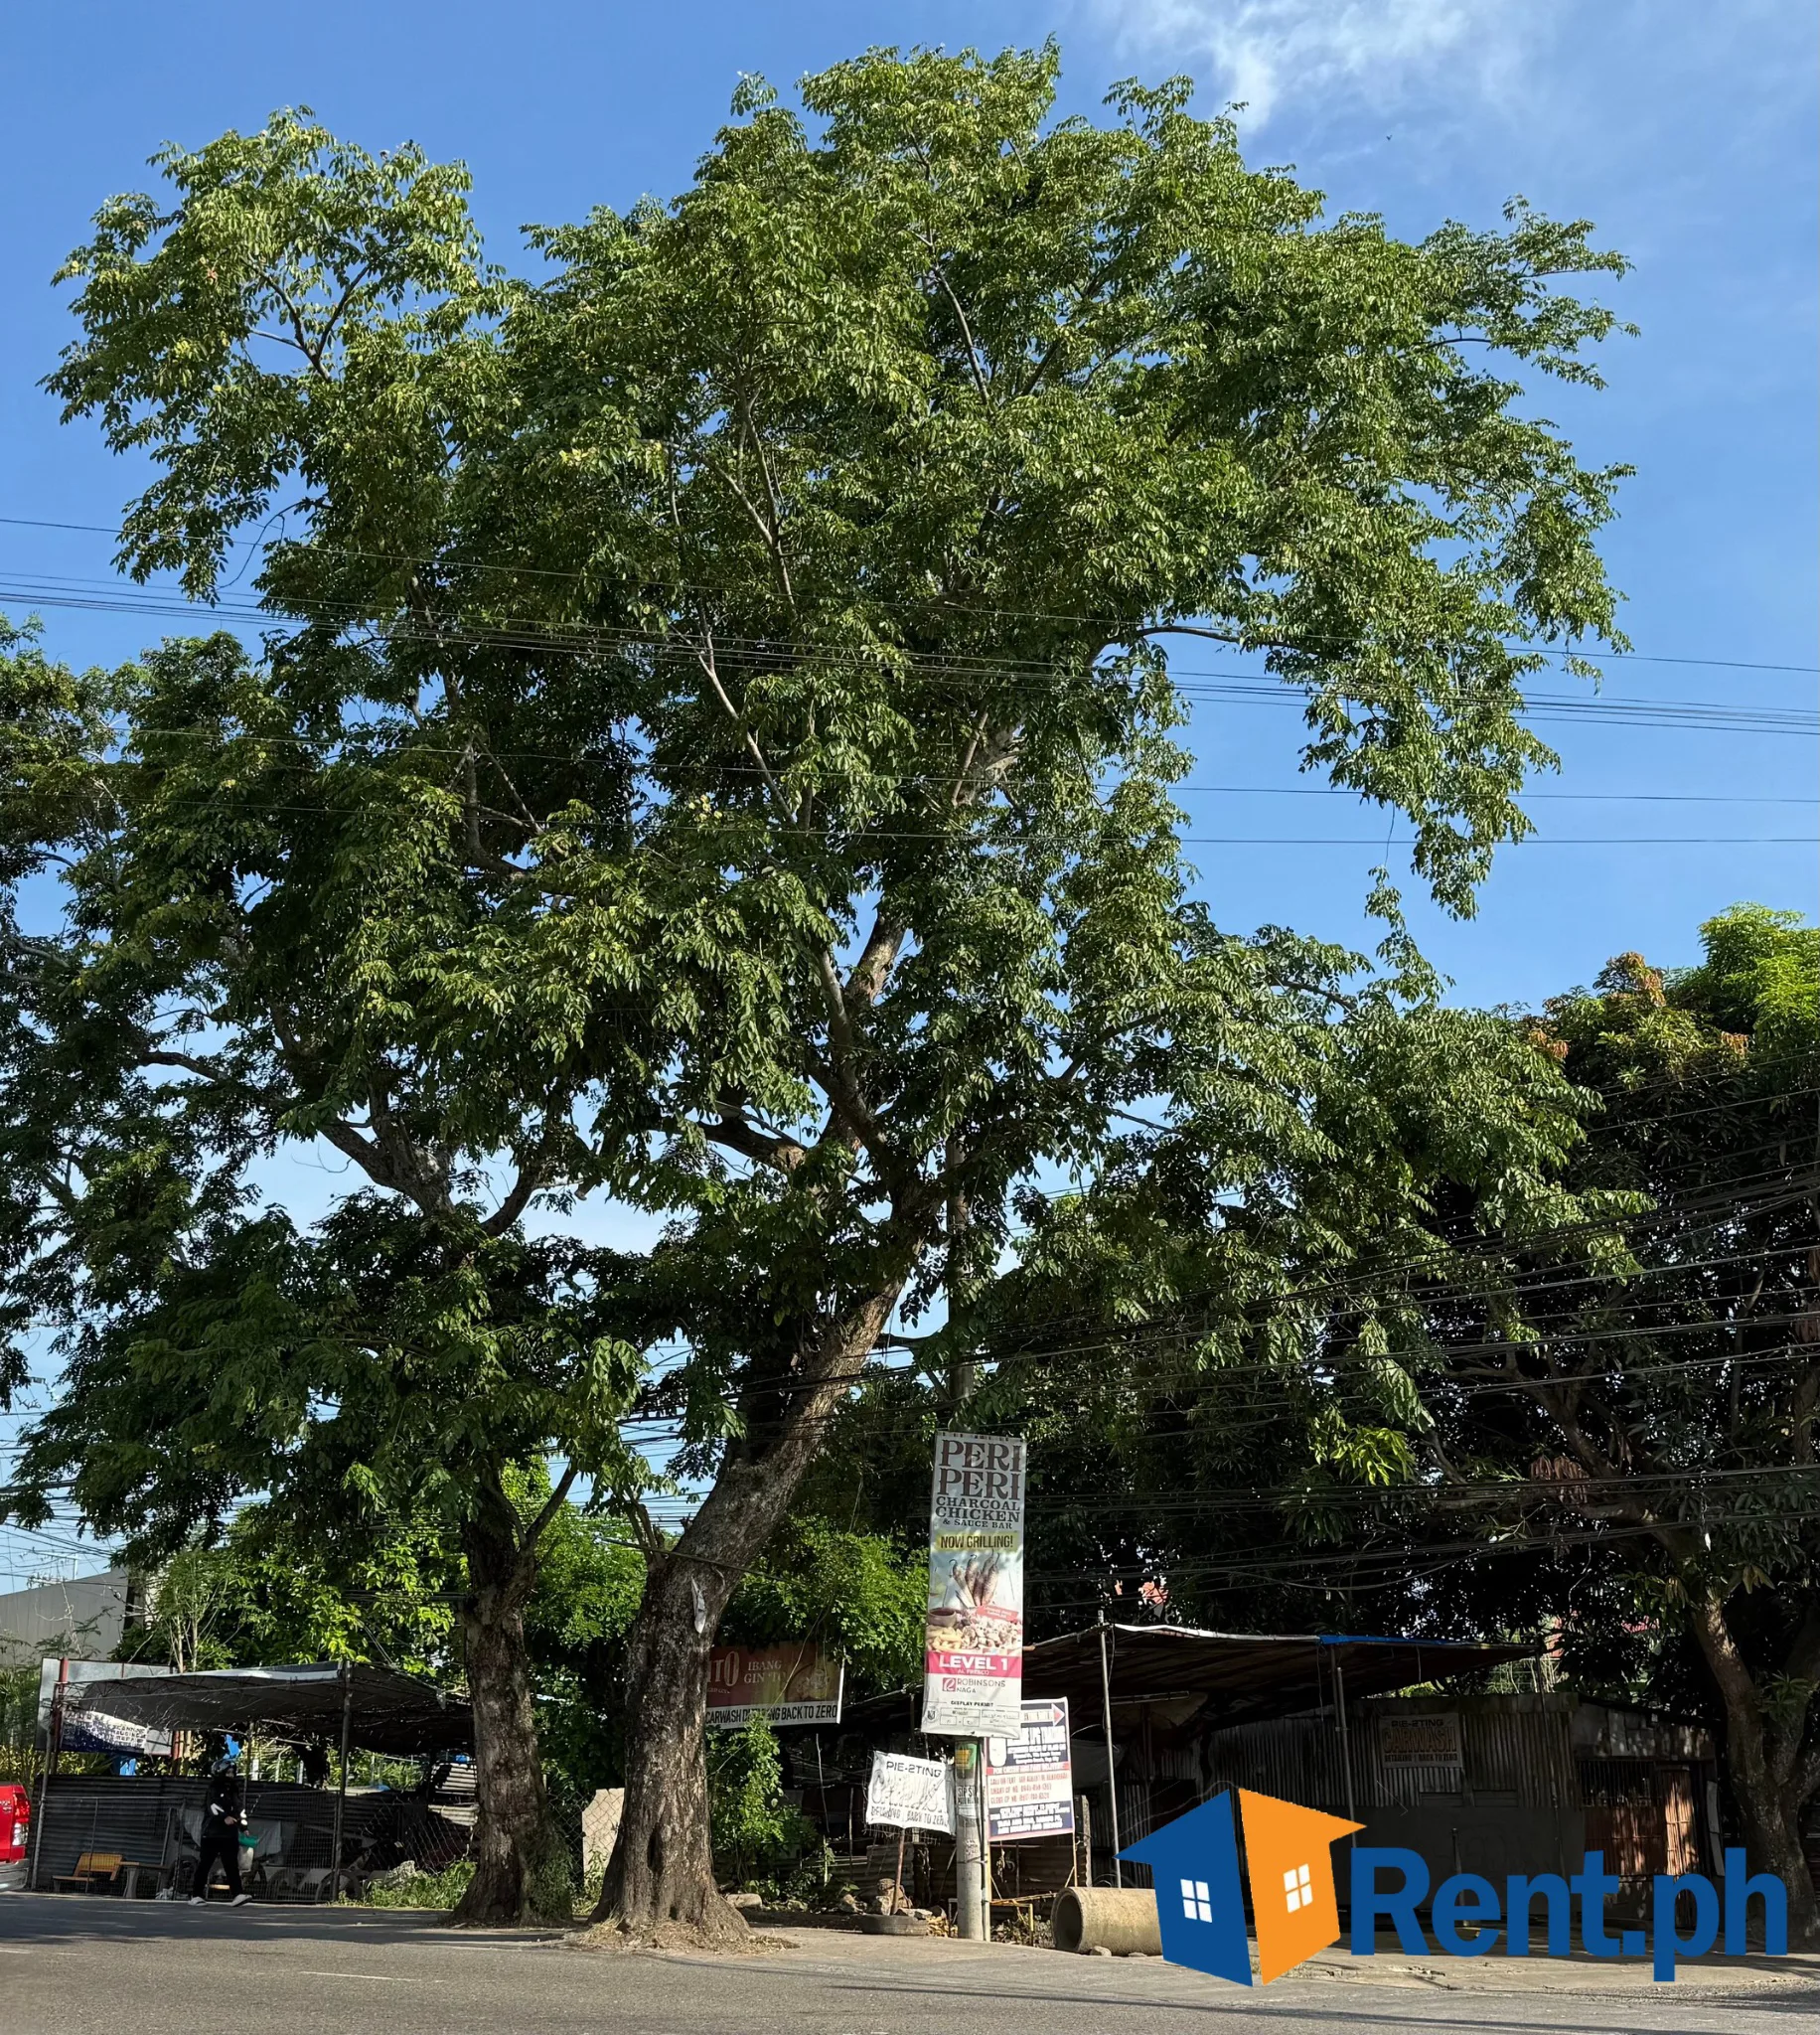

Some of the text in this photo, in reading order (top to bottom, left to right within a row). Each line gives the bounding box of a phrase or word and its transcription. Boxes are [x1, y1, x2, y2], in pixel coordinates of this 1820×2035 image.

[939, 1439, 1022, 1473] PERI
[938, 1468, 1020, 1500] PERI
[936, 1495, 1020, 1511] CHARCOAL
[936, 1506, 1020, 1523] CHICKEN
[954, 1518, 988, 1528] SAUCE
[940, 1535, 1013, 1549] NOW GRILLING!
[747, 1659, 782, 1671] IBANG
[939, 1654, 1008, 1671] LEVEL 1
[743, 1672, 765, 1684] GIN
[957, 1677, 1006, 1688] ROBINSONS
[706, 1708, 741, 1724] CARWASH
[781, 1706, 804, 1720] BACK
[804, 1705, 814, 1719] TO
[816, 1705, 837, 1719] ZERO
[1383, 1727, 1457, 1753] CARWASH
[886, 1761, 943, 1778] PIE-2TING
